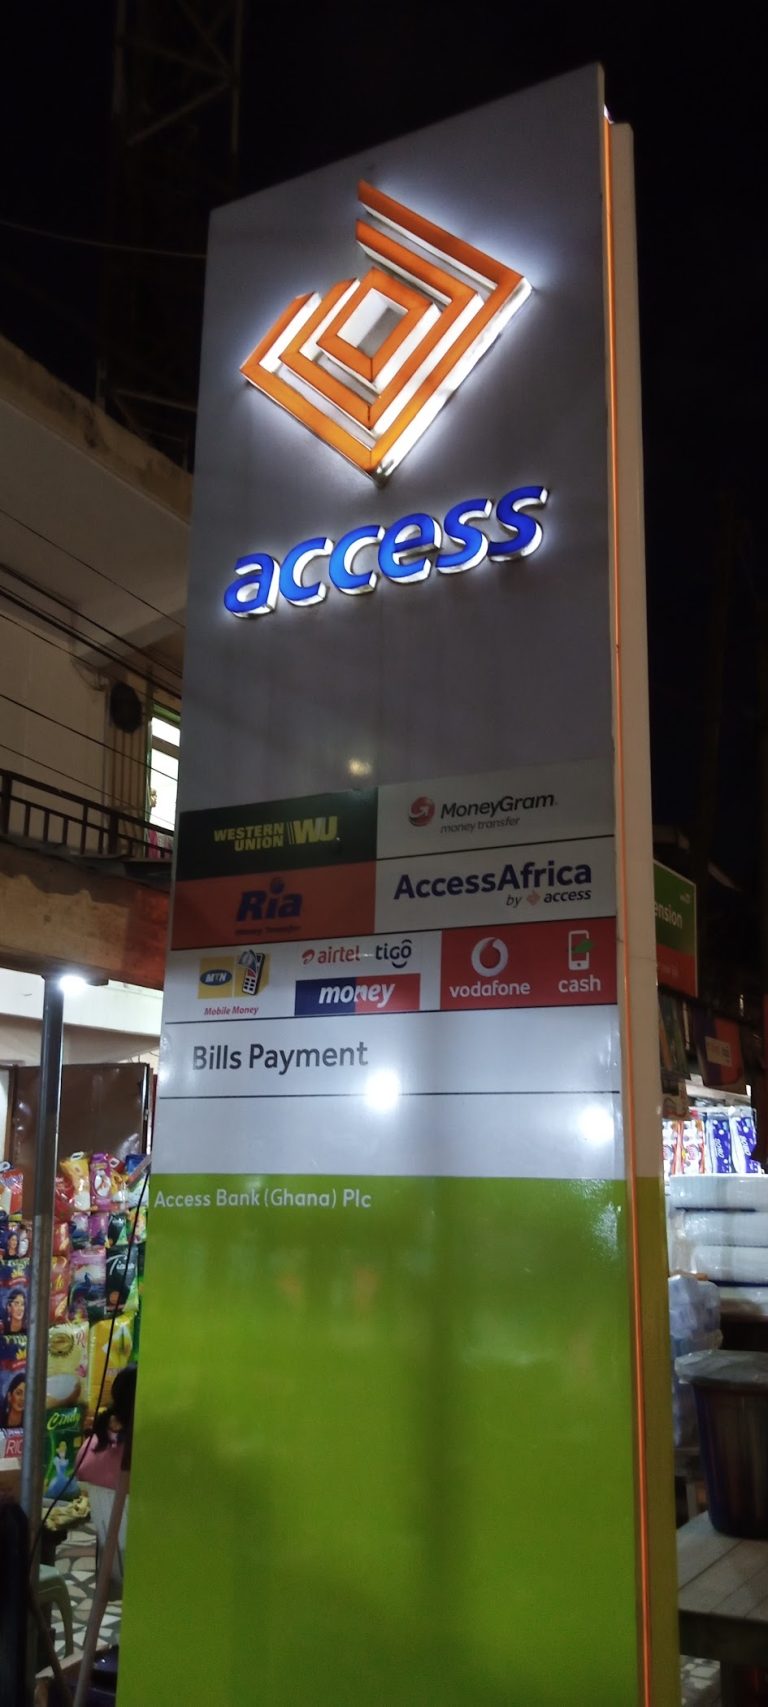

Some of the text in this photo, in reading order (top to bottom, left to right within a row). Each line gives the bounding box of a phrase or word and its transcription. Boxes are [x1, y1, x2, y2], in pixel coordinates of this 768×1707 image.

[223, 486, 549, 618] access
[440, 794, 557, 819] MoneyGram
[213, 815, 339, 845] WESTERN WU
[440, 815, 521, 834] money transfer
[234, 835, 284, 852] UNION
[393, 860, 592, 900] AccessAfrica
[236, 877, 303, 923] Ria
[506, 888, 592, 908] by access
[318, 946, 360, 964] airtel
[205, 971, 228, 983] MTN
[449, 974, 601, 998] vodafone cash
[318, 983, 396, 1009] money
[204, 1006, 259, 1016] Mobile Money
[193, 1041, 369, 1075] Bills Payment
[154, 1188, 372, 1208] Access Bank (Ghana) Plc
